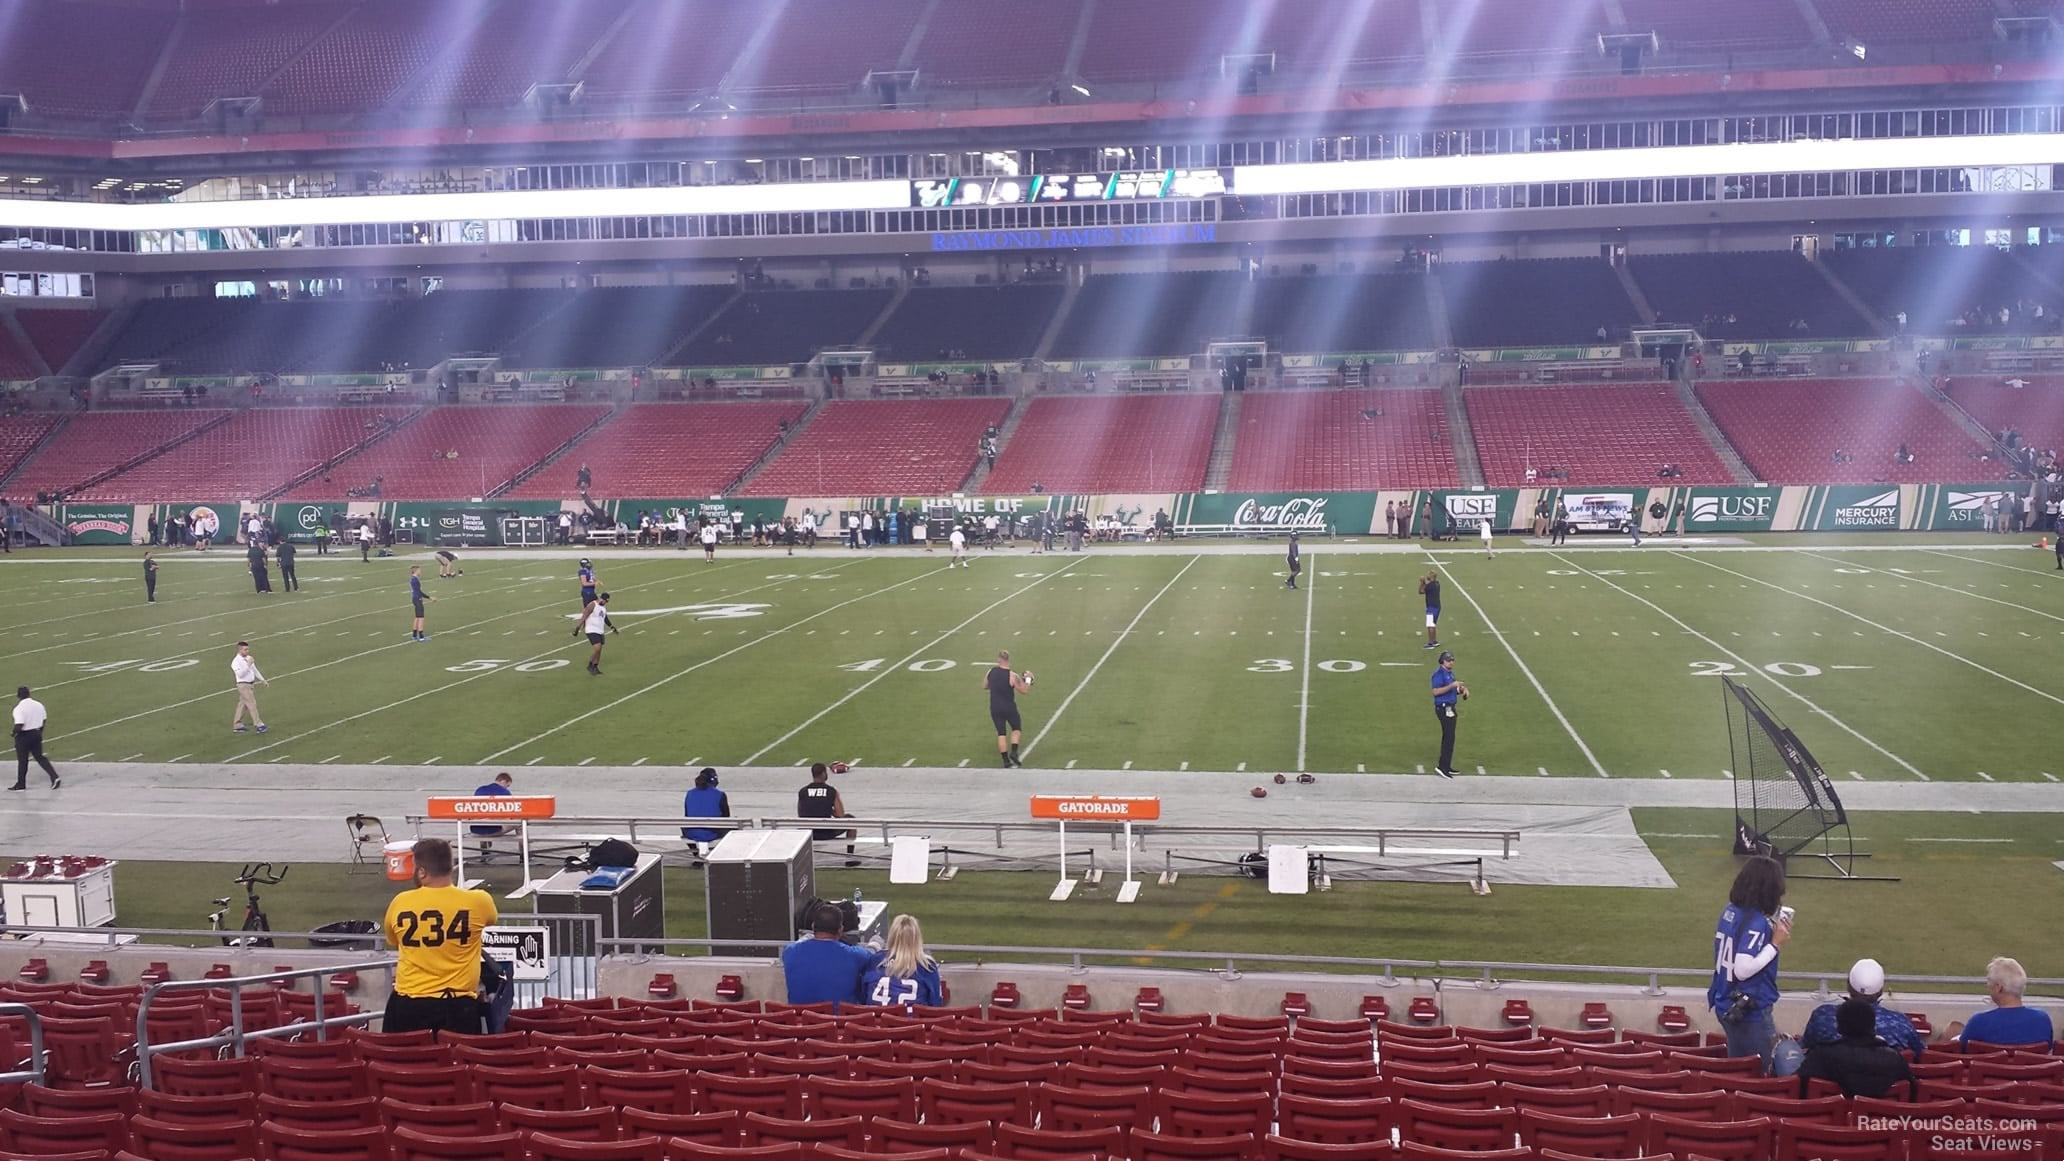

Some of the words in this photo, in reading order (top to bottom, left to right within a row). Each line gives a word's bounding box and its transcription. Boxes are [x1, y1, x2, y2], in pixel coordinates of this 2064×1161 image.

[932, 230, 1041, 251] RAYMOND
[1045, 227, 1115, 248] JAMES
[1119, 223, 1216, 245] STADIUM
[699, 503, 725, 511] Tampa
[994, 498, 1024, 513] OF
[1449, 498, 1494, 515] USF
[1568, 505, 1584, 513] AM
[1722, 496, 1771, 516] USF
[1836, 507, 1896, 518] MERCURY
[1948, 509, 1972, 521] ASI
[442, 517, 460, 525] TGH
[1835, 517, 1896, 526] INSURANCE
[807, 788, 827, 797] WBI
[455, 802, 522, 813] GATORADE
[1058, 802, 1128, 814] GATORADE
[390, 857, 398, 867] G
[397, 910, 471, 947] 234
[482, 933, 519, 944] WARNING
[1716, 931, 1734, 982] 74
[872, 976, 918, 1006] 42
